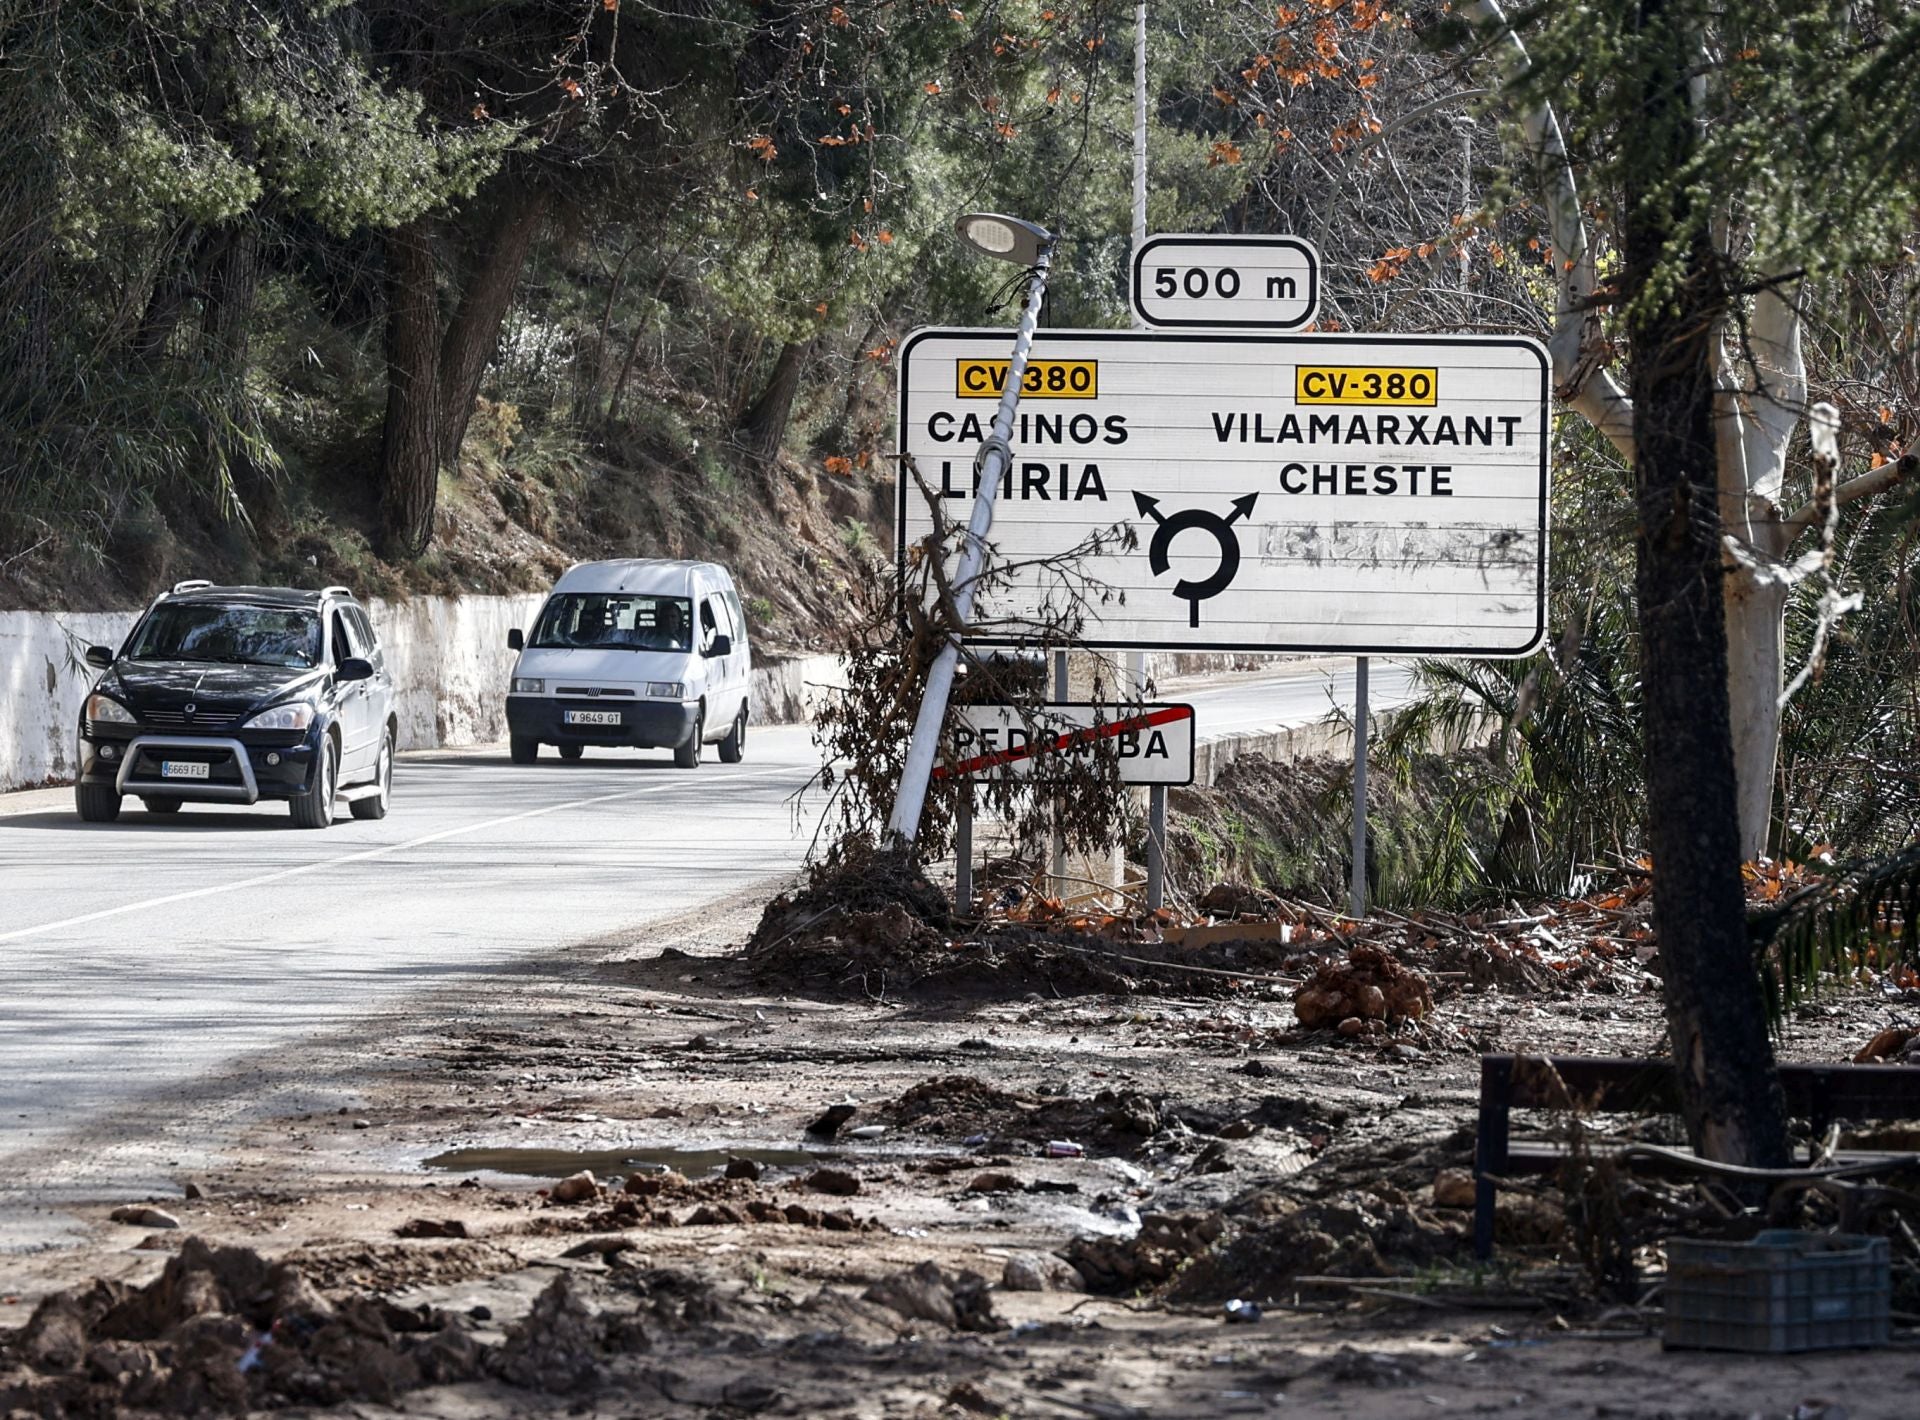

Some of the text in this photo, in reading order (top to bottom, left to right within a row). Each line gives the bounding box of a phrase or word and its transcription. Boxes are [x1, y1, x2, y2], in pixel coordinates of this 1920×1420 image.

[1155, 267, 1297, 299] 500 m
[964, 365, 1091, 392] CV380
[1303, 372, 1431, 400] CV-380
[1211, 412, 1522, 446] VILAMARXANT
[1279, 462, 1453, 496] CHESTE
[570, 712, 620, 724] V 9649 GT
[953, 728, 1169, 759] PEDRABA
[191, 765, 208, 776] FLF
